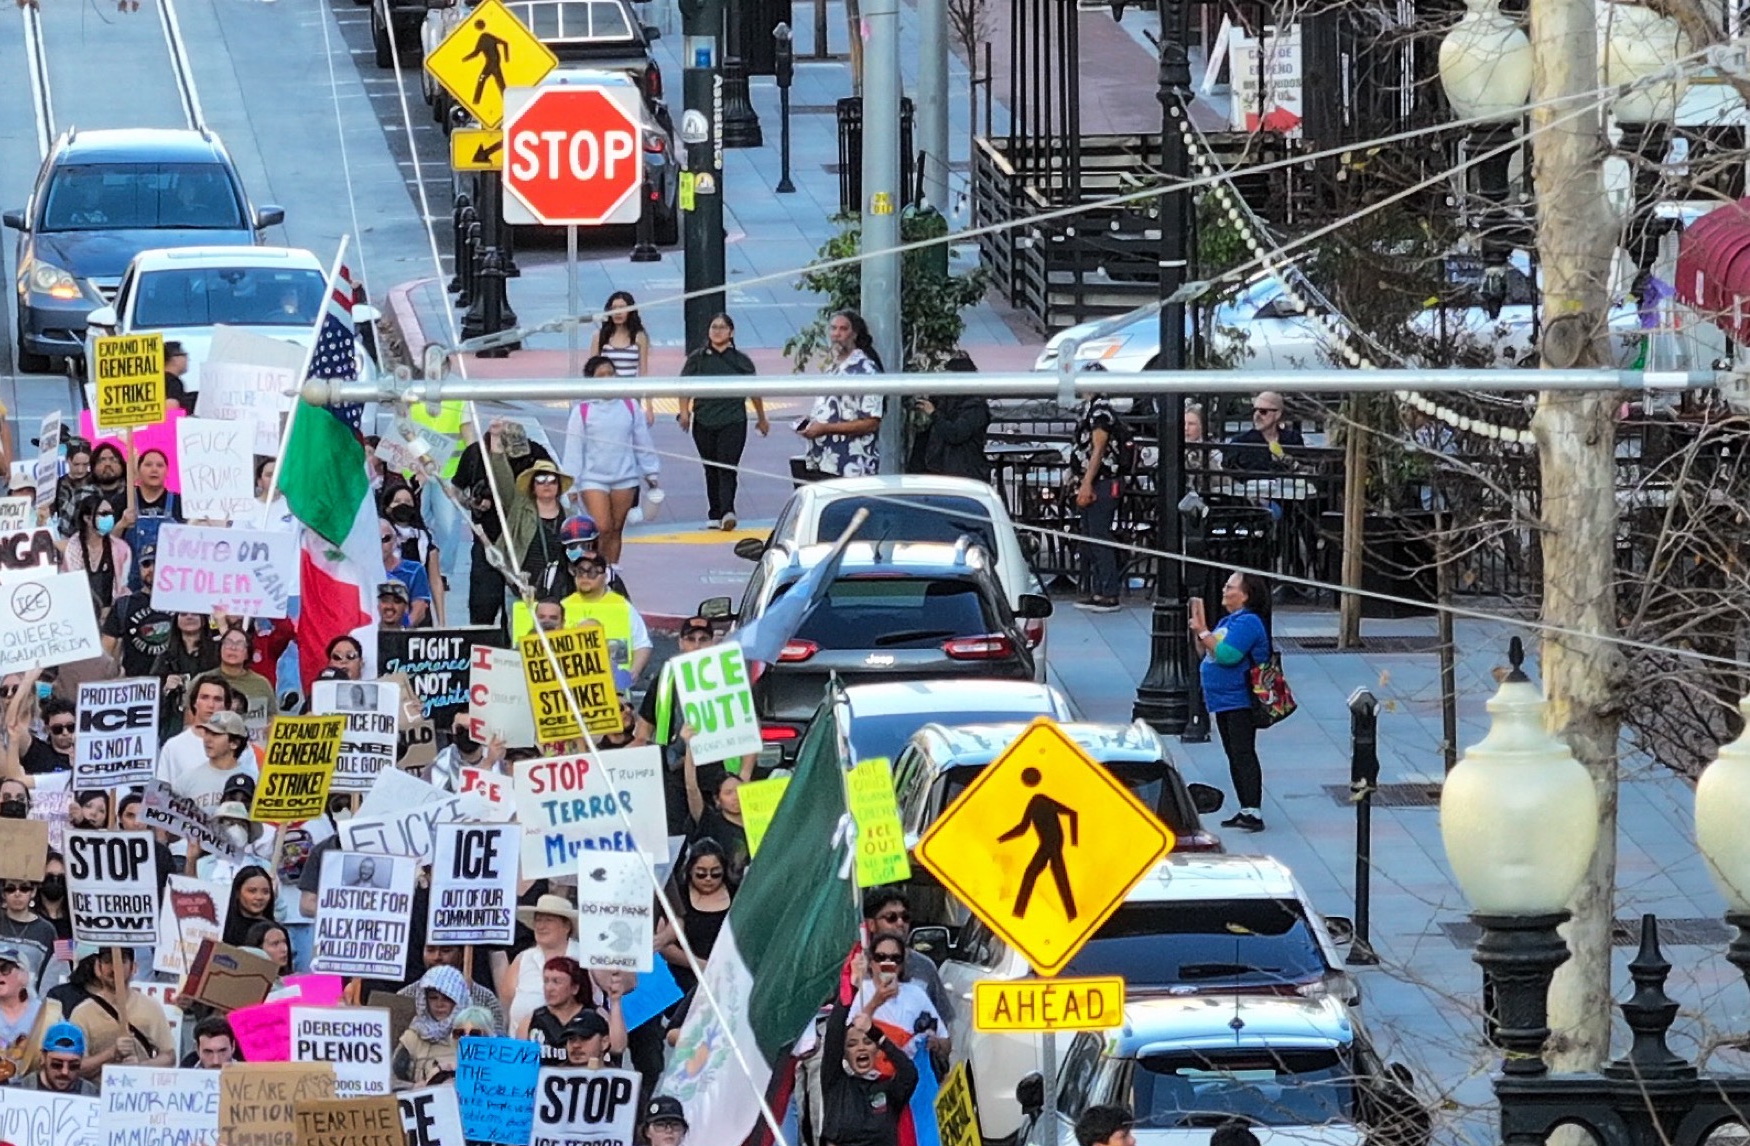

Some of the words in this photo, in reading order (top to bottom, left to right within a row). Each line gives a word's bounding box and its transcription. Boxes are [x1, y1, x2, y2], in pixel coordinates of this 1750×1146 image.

[712, 74, 724, 170] Assistance
[511, 130, 635, 181] STOP
[100, 356, 159, 378] GENERAL
[104, 382, 156, 405] STRIKE!
[3, 621, 74, 648] QUEERS
[408, 638, 464, 660] FIGHT
[415, 672, 452, 695] NOT
[681, 649, 744, 692] ICE
[80, 685, 155, 705] PROTESTING
[80, 705, 153, 733] ICE
[685, 691, 752, 733] OUT!
[274, 721, 314, 741] EXPAND
[317, 719, 341, 738] THE
[268, 739, 335, 766] GENERAL
[78, 758, 152, 774] CRIME!
[527, 759, 590, 794] STOP
[264, 771, 325, 797] STRIKE!
[69, 836, 149, 881] STOP
[452, 830, 503, 880] ICE
[72, 892, 95, 912] ICE
[98, 894, 152, 913] TERROR
[320, 891, 375, 911] JUSTICE
[378, 893, 409, 912] FOR
[75, 913, 153, 931] NOW!
[318, 917, 352, 940] ALEX
[355, 920, 406, 946] PRETTI
[434, 909, 510, 928] COMMUNITIES
[993, 990, 1105, 1024] AHEAD
